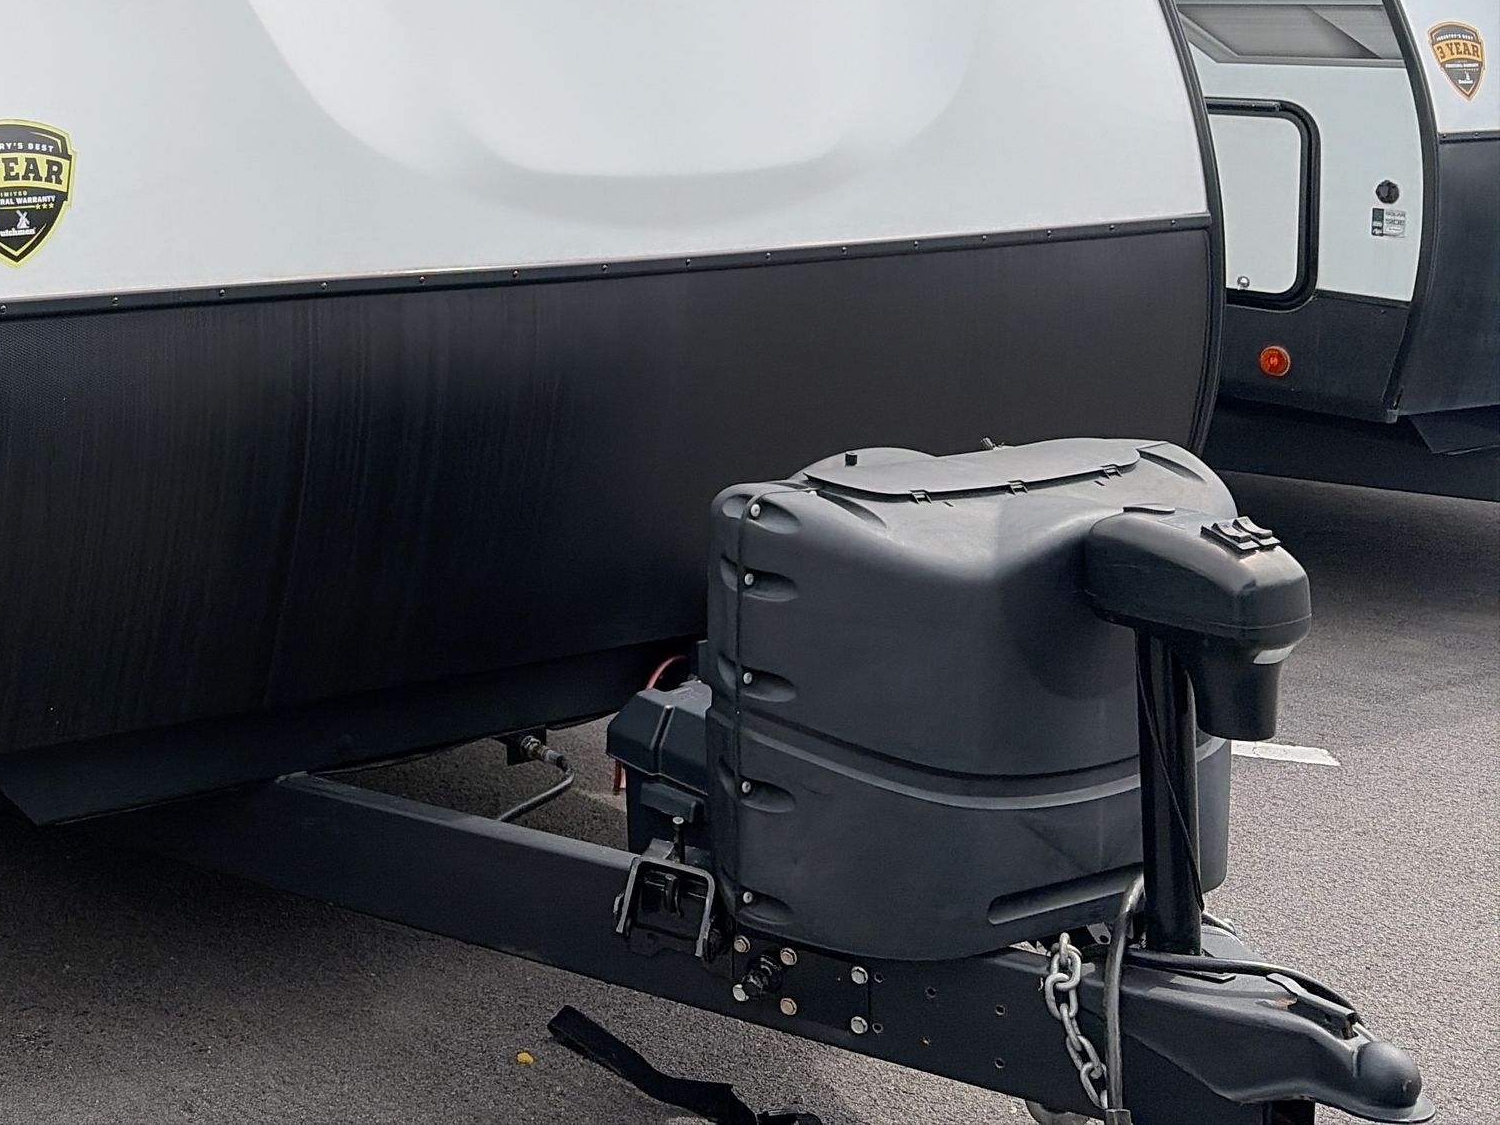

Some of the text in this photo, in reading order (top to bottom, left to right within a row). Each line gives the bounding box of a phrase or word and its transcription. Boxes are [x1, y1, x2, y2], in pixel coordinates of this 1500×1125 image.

[1437, 42, 1480, 59] 3 YEAR
[28, 142, 55, 153] BEST
[15, 195, 56, 205] WARRANTY
